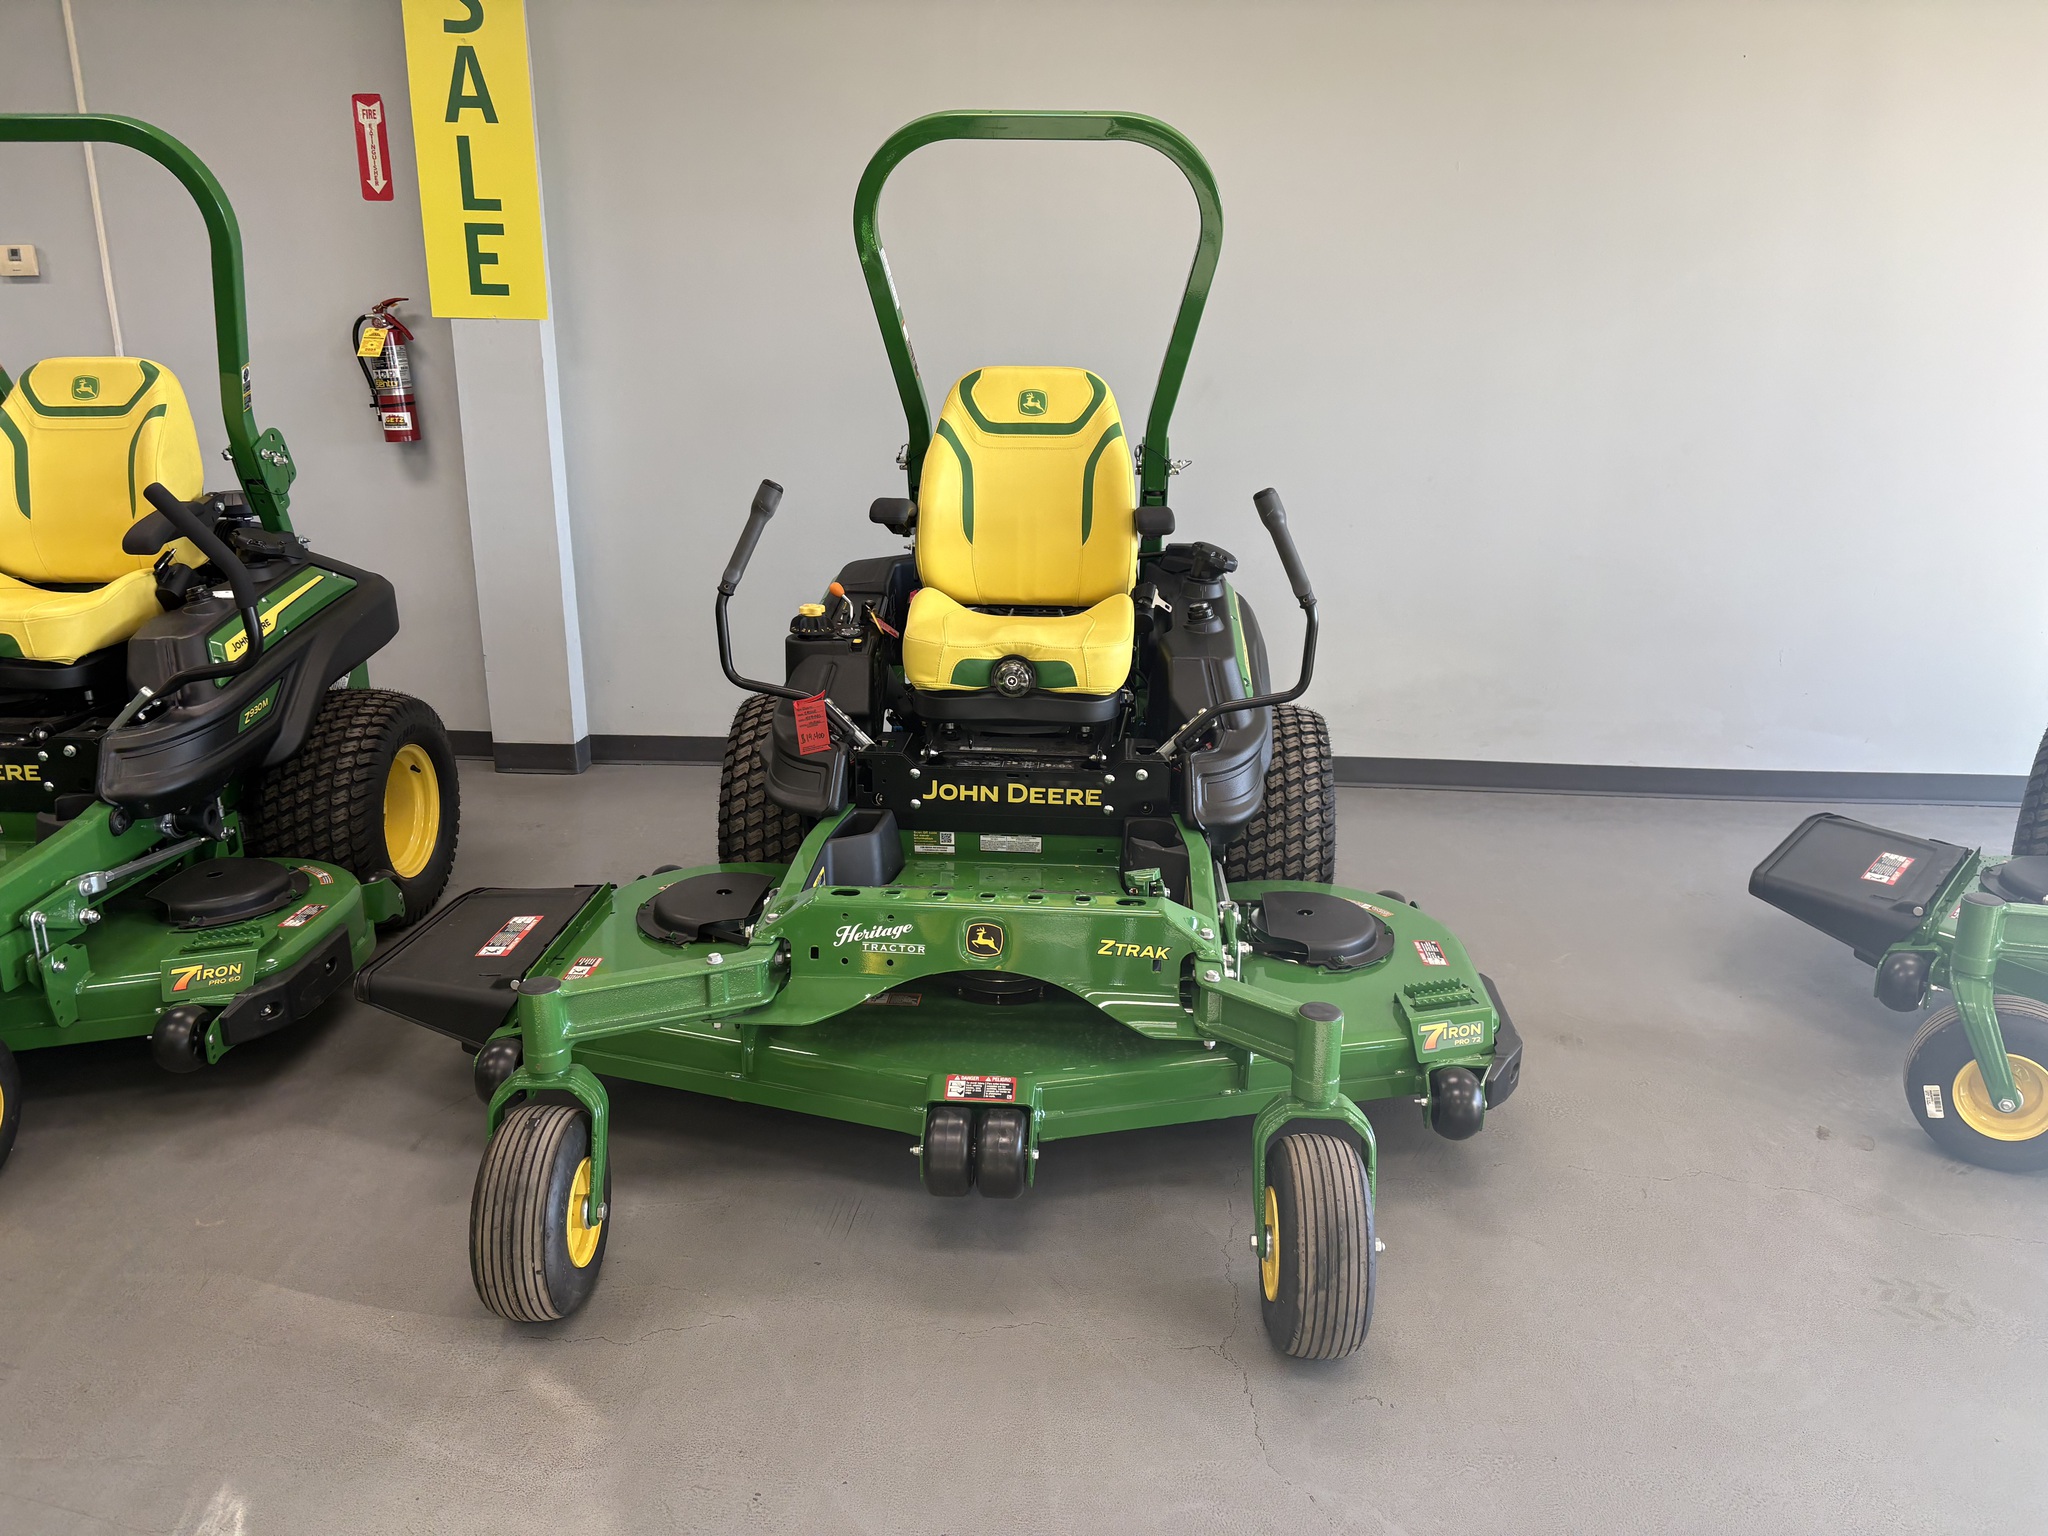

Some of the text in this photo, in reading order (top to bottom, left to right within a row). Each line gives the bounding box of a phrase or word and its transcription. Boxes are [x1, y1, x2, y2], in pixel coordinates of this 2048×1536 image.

[361, 109, 377, 120] FIRE
[368, 123, 379, 186] EXTINGUISHER
[244, 697, 269, 725] Z930M
[922, 780, 1102, 806] JOHN DEERE
[833, 923, 913, 947] Heritage
[862, 943, 925, 953] TRACTOR
[1097, 939, 1171, 960] ZTRAK
[208, 975, 241, 986] PRO 60
[1454, 1038, 1469, 1046] PRO
